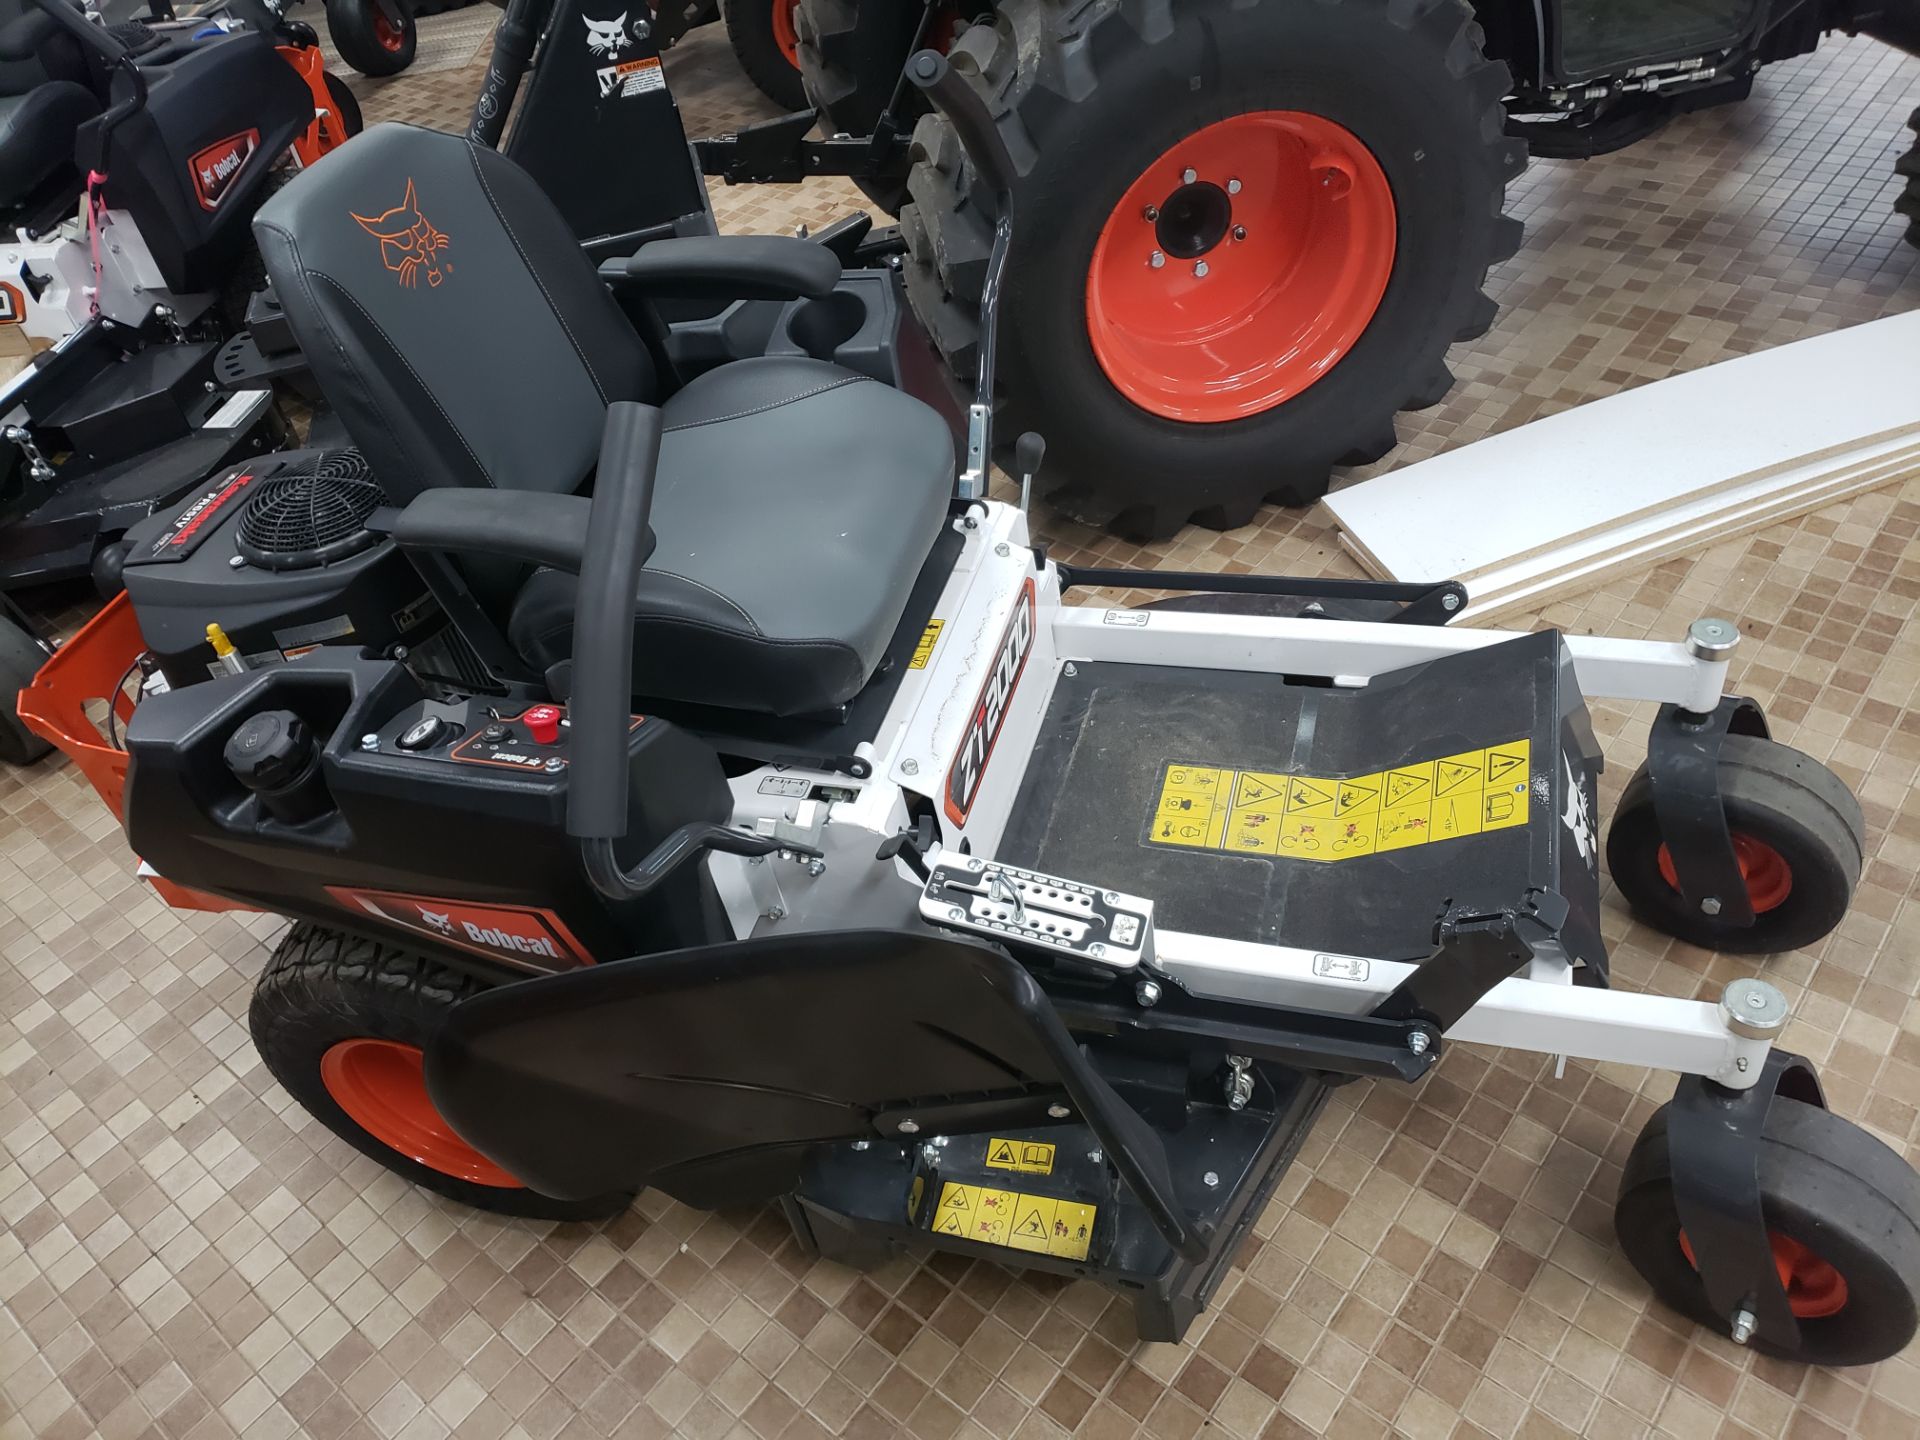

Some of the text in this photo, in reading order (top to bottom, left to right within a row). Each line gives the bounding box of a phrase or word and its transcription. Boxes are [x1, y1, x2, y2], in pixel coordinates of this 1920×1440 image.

[626, 58, 659, 71] WARNING
[213, 148, 241, 180] Bobcat
[169, 475, 254, 545] Kawasaki
[961, 595, 1031, 806] ZT2000
[461, 920, 559, 959] Bobcat
